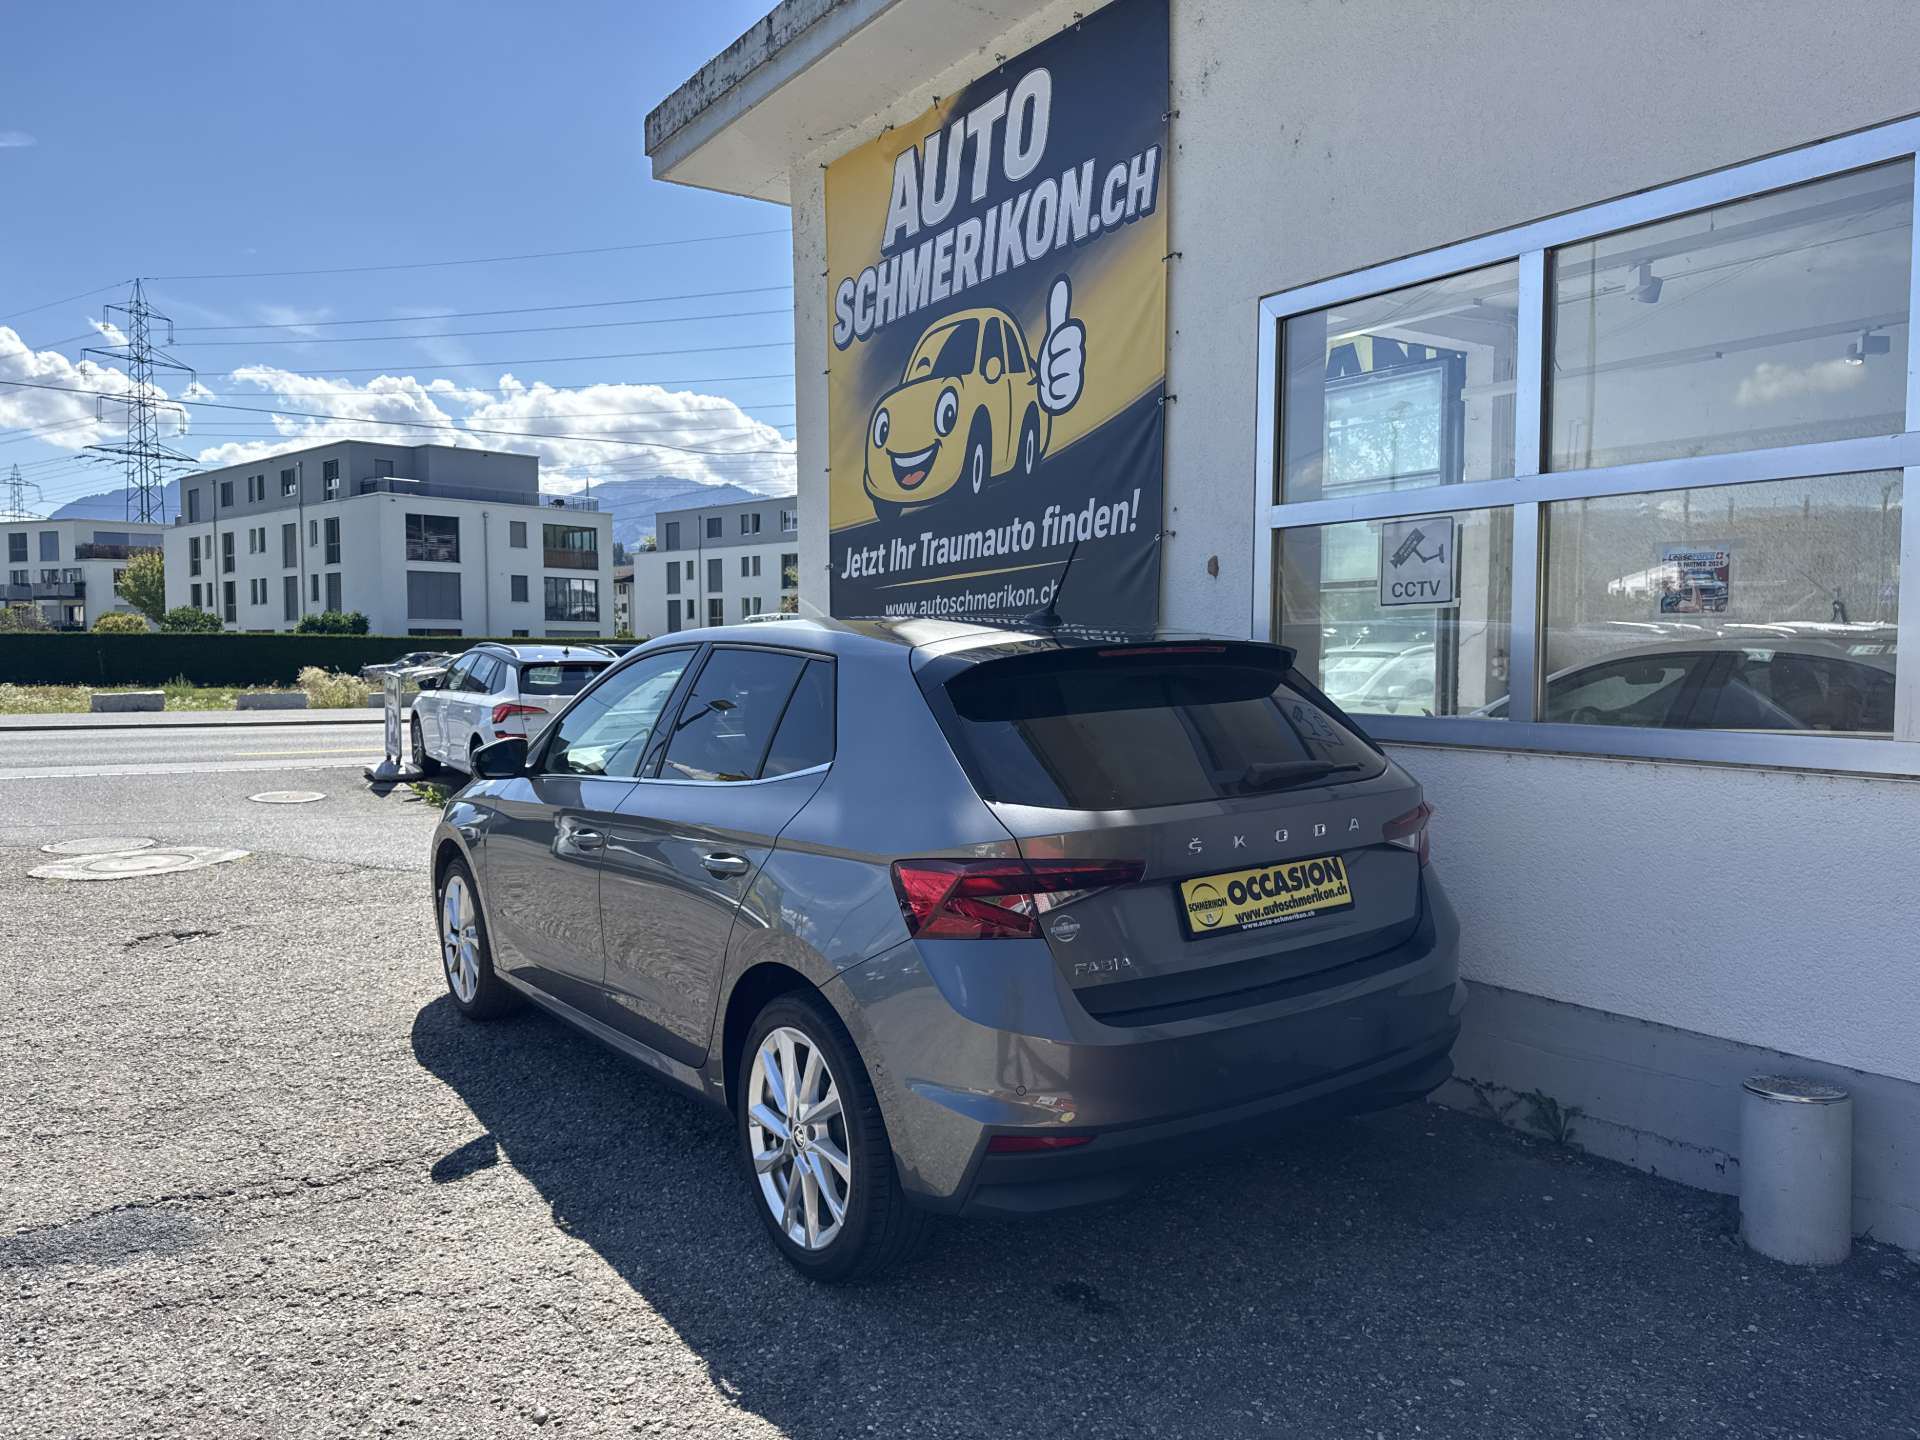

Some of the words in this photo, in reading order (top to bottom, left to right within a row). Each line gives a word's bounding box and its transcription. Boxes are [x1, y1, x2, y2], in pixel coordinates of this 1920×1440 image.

[881, 67, 1051, 256] AUTO
[833, 145, 1161, 350] SCHMERIKON.CH
[841, 547, 886, 579] Jetzt
[889, 540, 914, 572] Ihr
[920, 517, 1035, 566] Traumauto
[1041, 488, 1141, 548] finden!
[885, 579, 1060, 616] www.autoschmerikon.ch
[1391, 580, 1441, 597] CCTV
[1227, 857, 1343, 905] OCCASION
[1235, 881, 1348, 923] www.autoschmerikon.ch
[1074, 957, 1132, 976] FABIA
